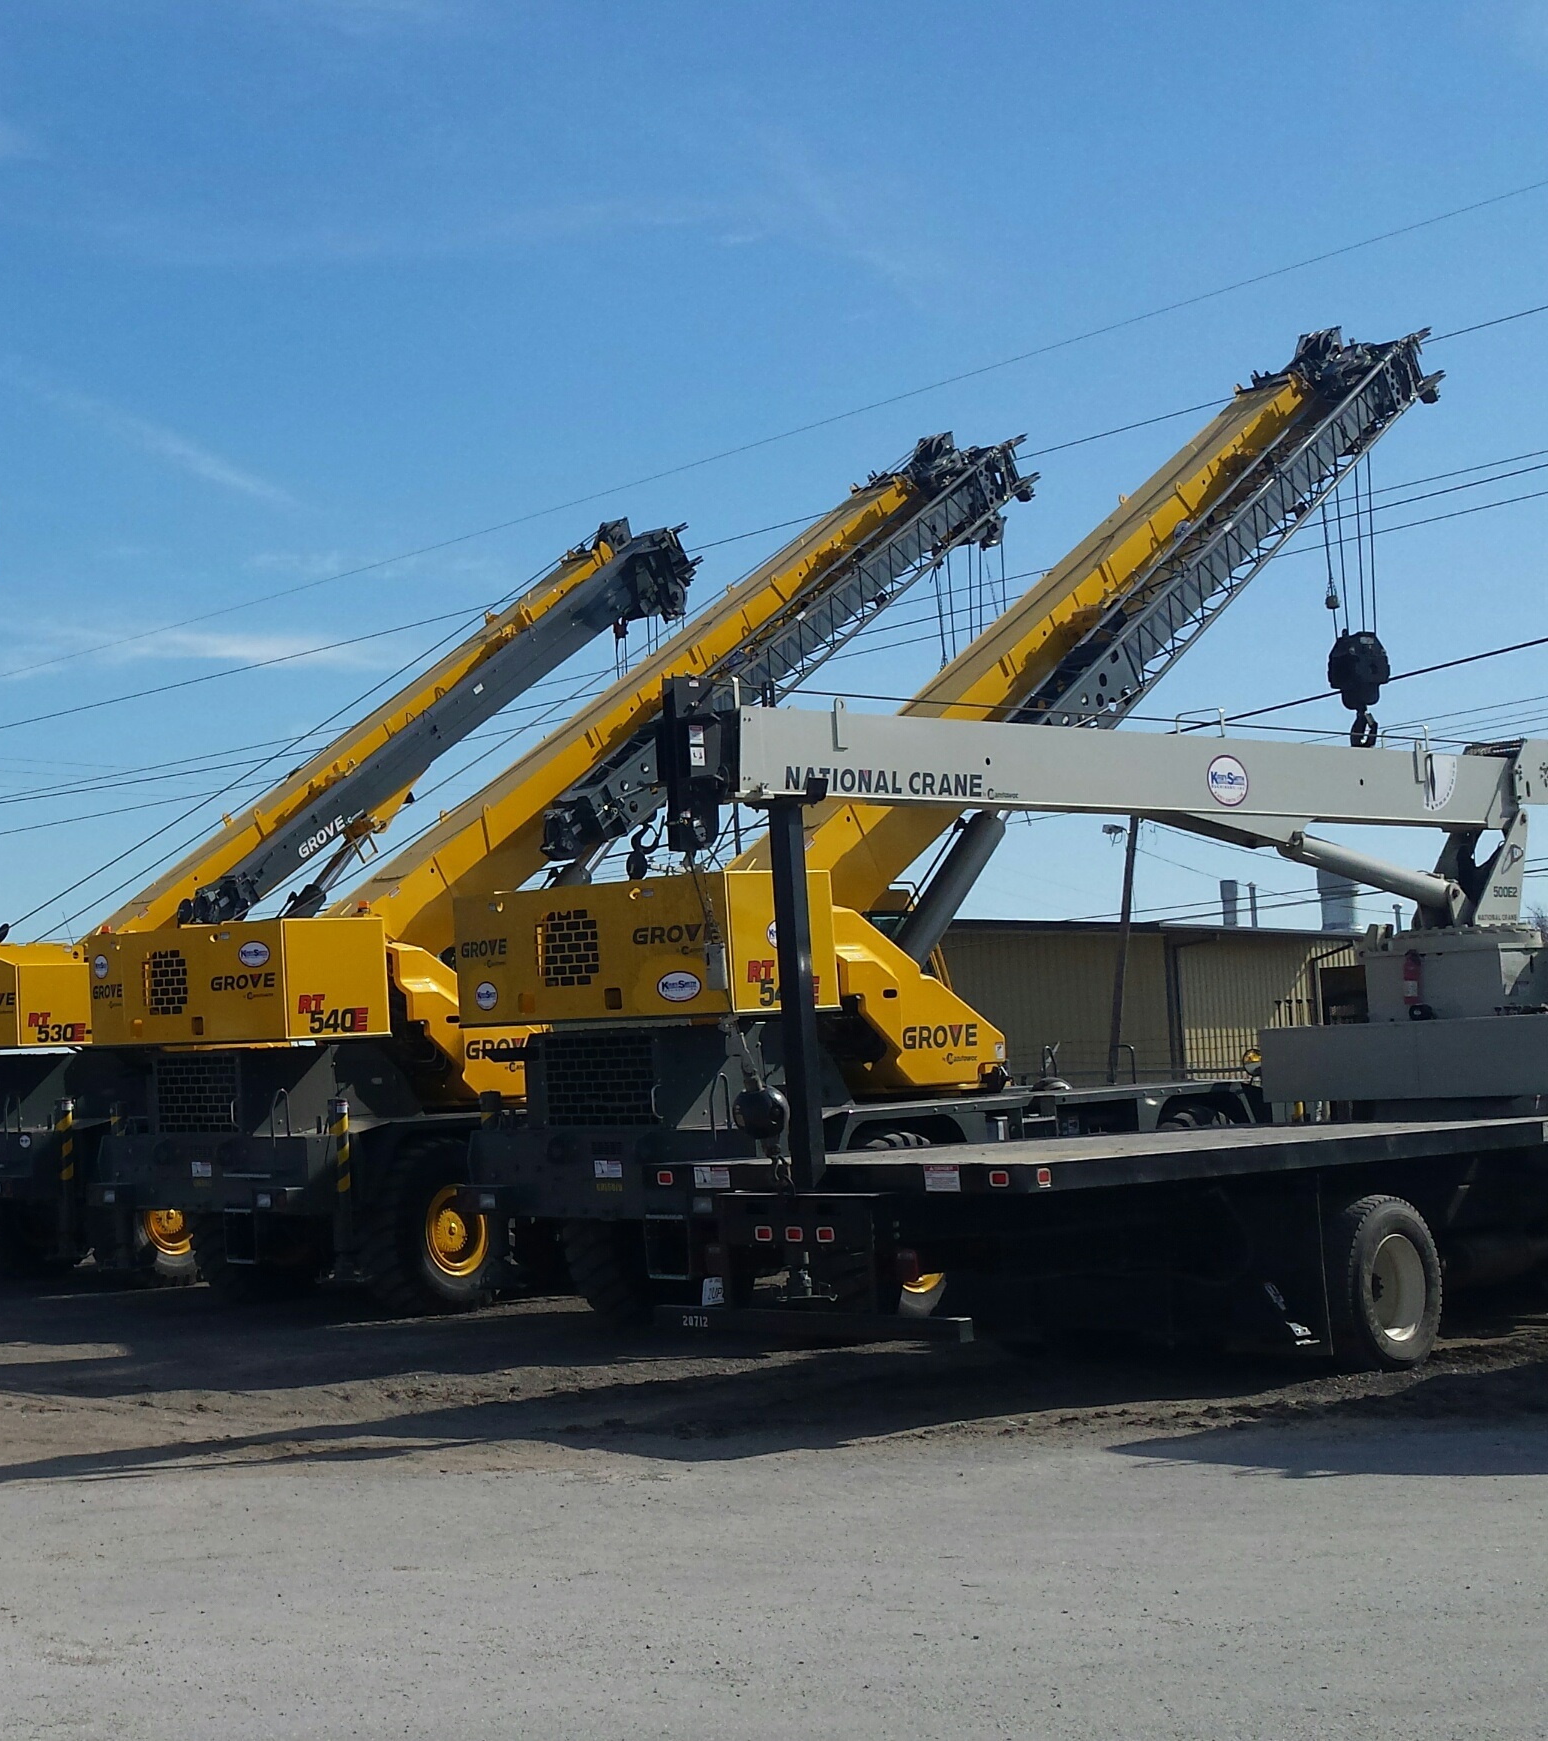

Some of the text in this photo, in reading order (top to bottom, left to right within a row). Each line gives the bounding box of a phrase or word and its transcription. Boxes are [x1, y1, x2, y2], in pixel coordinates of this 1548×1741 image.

[785, 766, 983, 797] NATIONAL CRANE
[298, 815, 345, 859] GROVE
[632, 923, 711, 945] GROV
[461, 939, 507, 958] GROVE
[210, 972, 275, 991] GROVE
[747, 960, 775, 983] RT
[93, 984, 122, 999] GROVE
[298, 994, 325, 1014] RT
[28, 1012, 51, 1027] RT
[309, 1007, 369, 1033] 540E
[902, 1023, 978, 1049] GROVE
[682, 1315, 709, 1328] 20712
